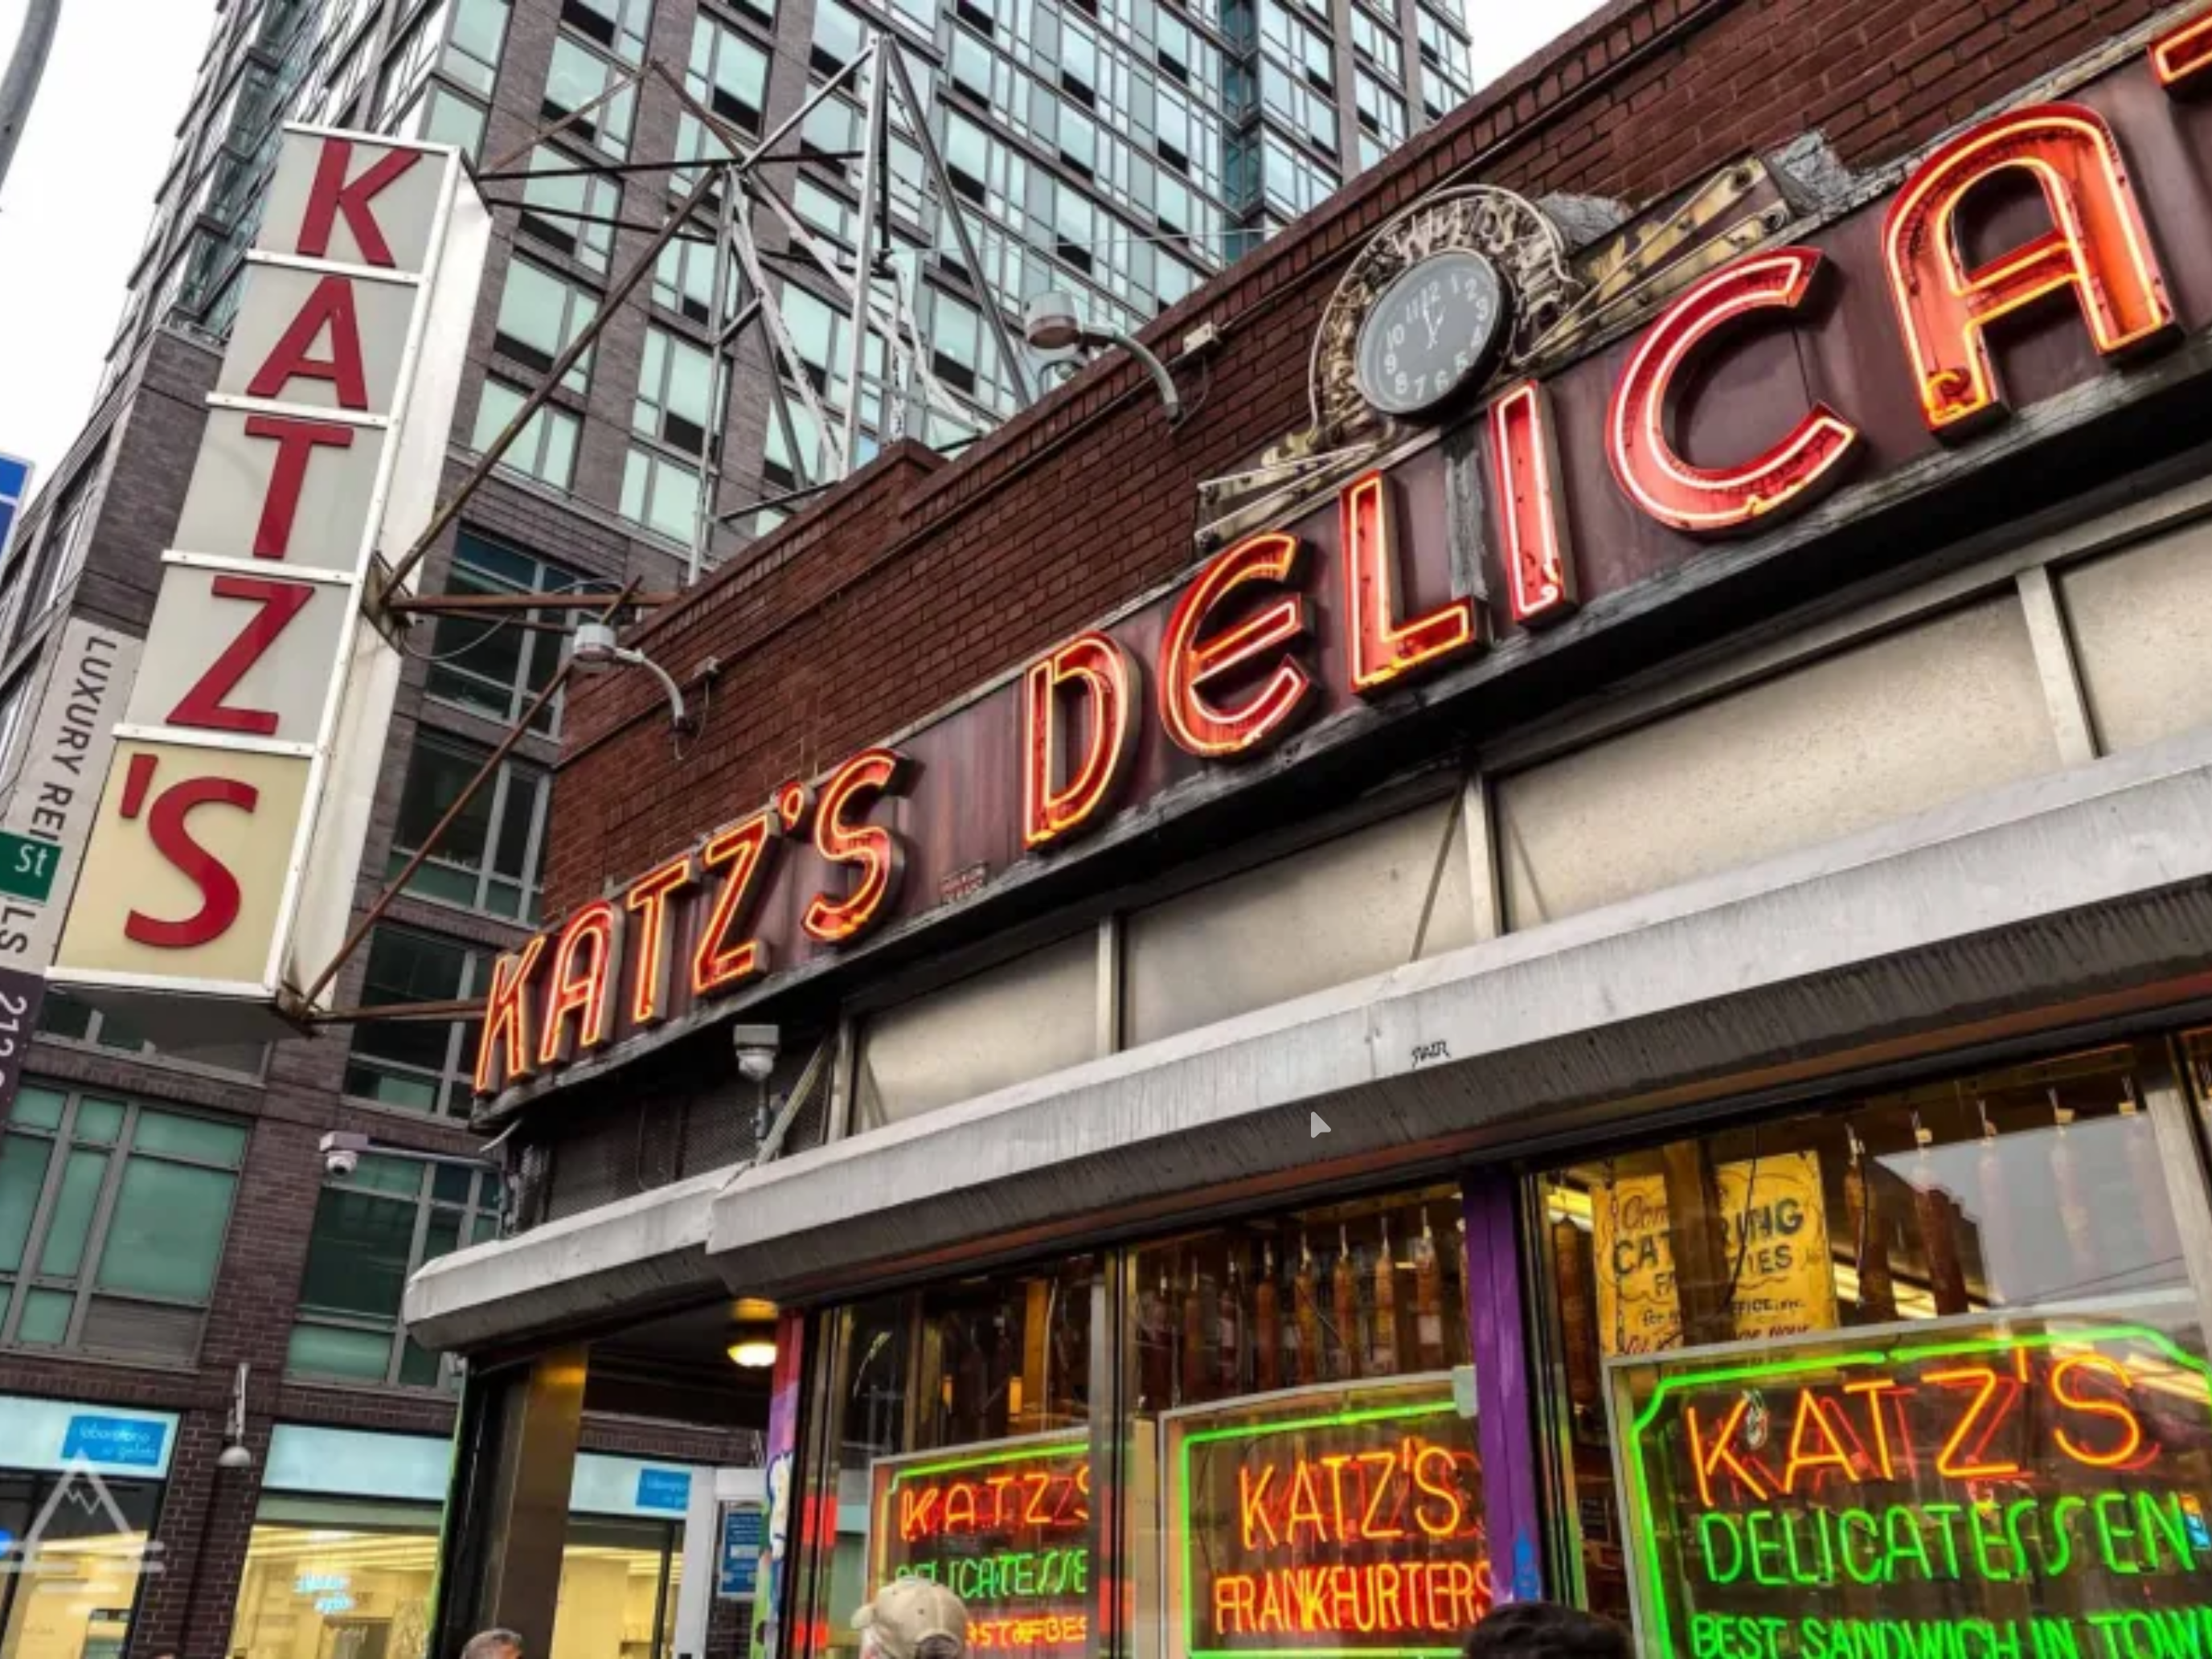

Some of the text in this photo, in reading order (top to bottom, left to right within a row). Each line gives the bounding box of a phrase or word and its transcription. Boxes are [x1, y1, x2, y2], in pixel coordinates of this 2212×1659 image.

[1383, 352, 1397, 375] 9
[1386, 323, 1406, 350] 10
[1394, 371, 1408, 395] 8
[1413, 373, 1428, 400] 7
[120, 137, 422, 950] KATZ'S
[51, 636, 117, 776] LUXURY
[14, 843, 48, 878] St
[473, 746, 902, 1095] KATZ'S
[1686, 1346, 2142, 1509] KATZ'S
[1239, 1436, 1462, 1551] KATZ'S
[1698, 1492, 2196, 1587] DELICATESSEN
[1215, 1561, 1493, 1635] FRANKFURTERS
[1690, 1612, 1787, 1659] BEST
[1800, 1616, 2020, 1659] SANDWICH
[2030, 1615, 2081, 1659] IN
